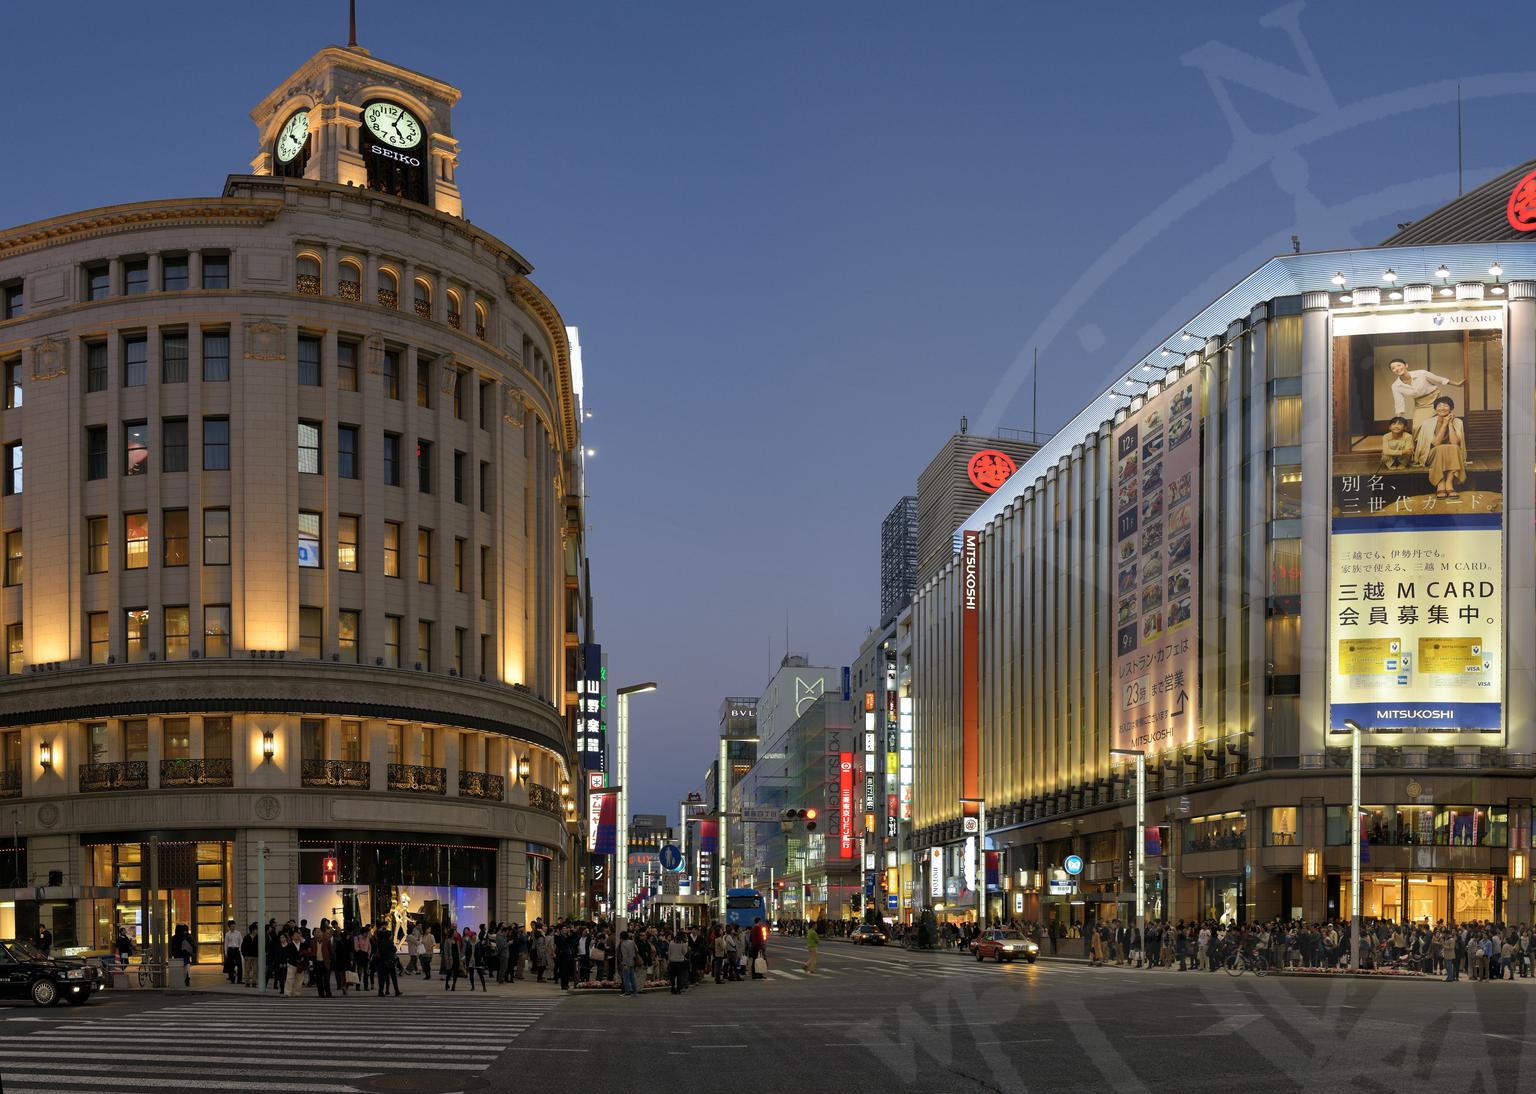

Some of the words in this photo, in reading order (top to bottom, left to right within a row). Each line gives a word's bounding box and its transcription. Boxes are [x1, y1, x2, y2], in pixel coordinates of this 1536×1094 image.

[371, 145, 420, 167] SEIKO
[1341, 475, 1397, 492] 別名、
[966, 535, 976, 610] MITSUKOSHI
[1338, 582, 1385, 601] 三越
[1397, 582, 1415, 598] M
[1426, 581, 1495, 598] CARD
[1338, 604, 1495, 626] 会員募集中。
[587, 680, 599, 752] 山野楽器
[1376, 709, 1454, 719] MITSUKOSHI
[1131, 728, 1174, 748] MITSUKOSHI
